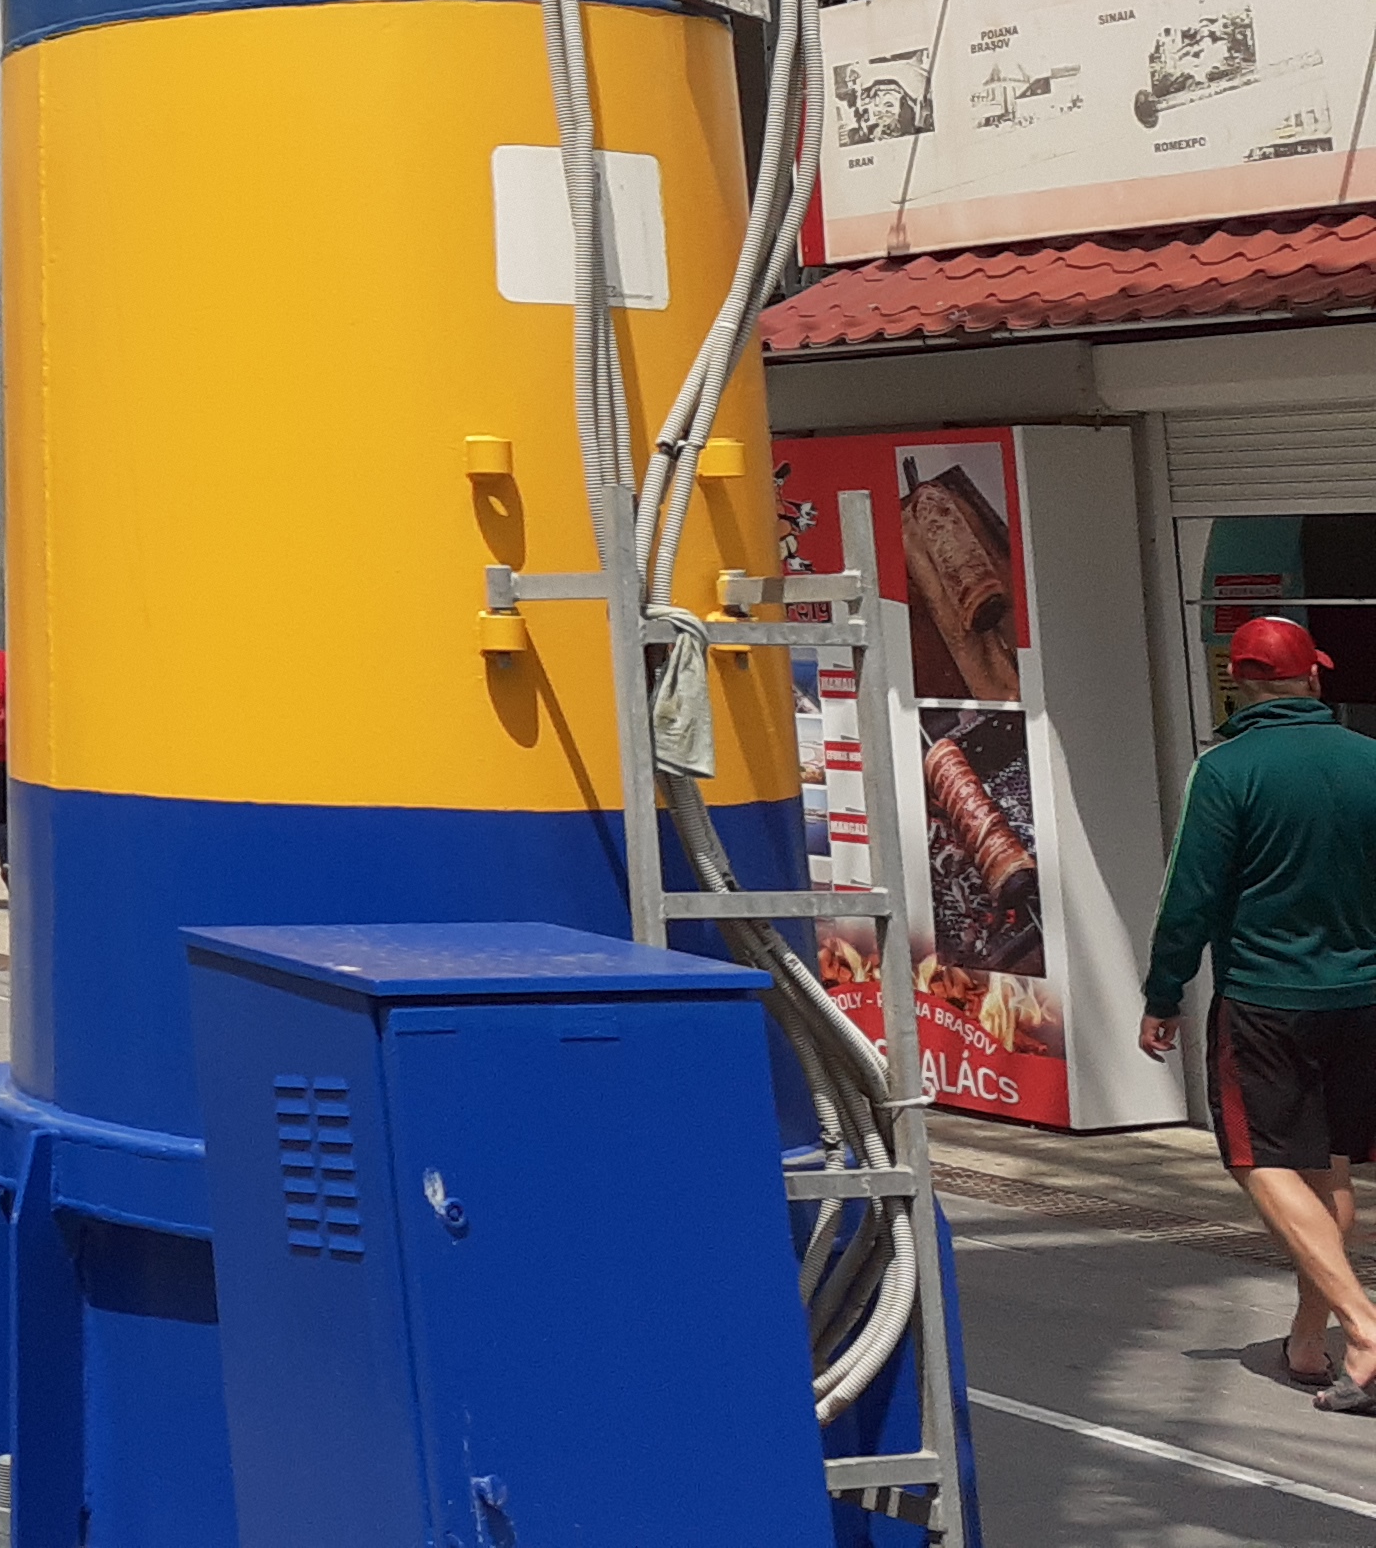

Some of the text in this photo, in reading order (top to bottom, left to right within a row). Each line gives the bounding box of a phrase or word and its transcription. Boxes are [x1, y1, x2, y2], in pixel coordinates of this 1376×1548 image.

[1098, 9, 1136, 26] SINAIA
[980, 25, 1019, 42] POIANA
[1153, 136, 1206, 153] ROMEXPO
[848, 155, 875, 169] BRAN
[919, 1048, 1020, 1105] ALÁCS
